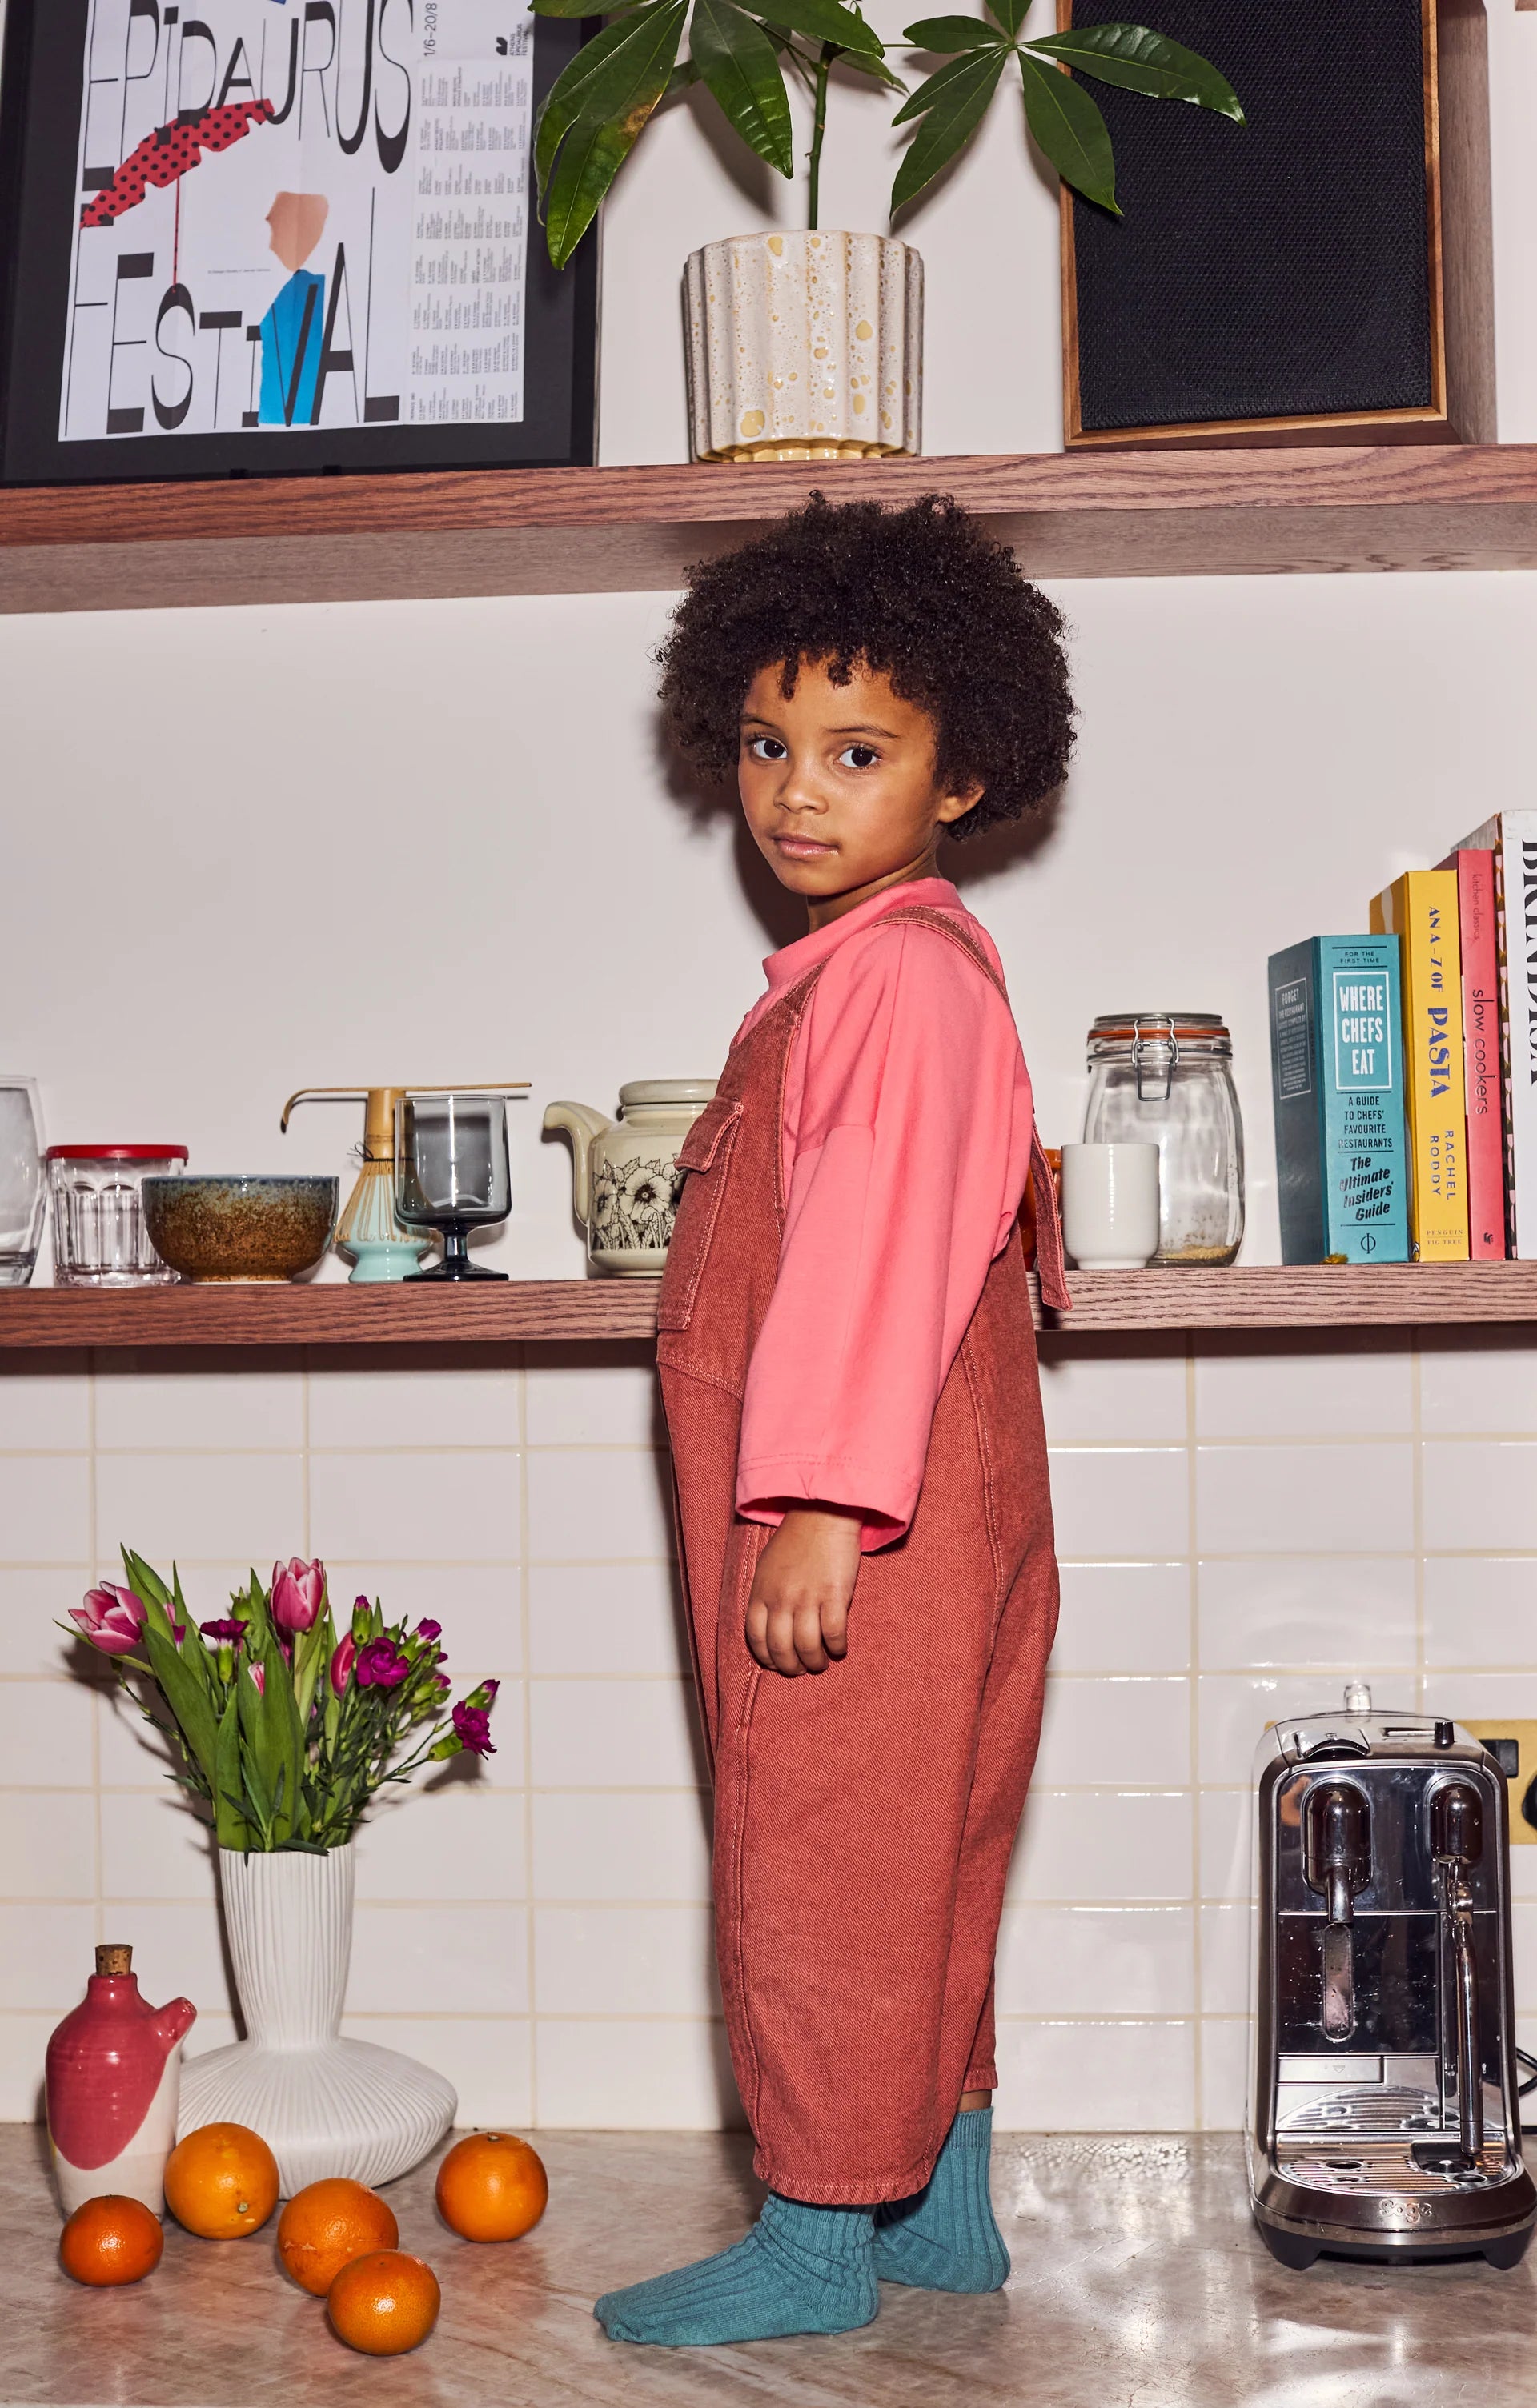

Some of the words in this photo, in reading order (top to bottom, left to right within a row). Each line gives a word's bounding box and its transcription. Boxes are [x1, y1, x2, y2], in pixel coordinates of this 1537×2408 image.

[82, 0, 414, 191] EPIDAURUS
[65, 187, 399, 437] FESTIVAL
[1471, 874, 1483, 905] kitchen
[1429, 906, 1441, 928] AN
[1473, 908, 1484, 940] classics
[1431, 972, 1443, 992] OF
[1282, 988, 1299, 1005] FORGET
[1339, 985, 1384, 1012] WHERE
[1472, 989, 1495, 1031] slow
[1342, 1017, 1383, 1043] CHEFS
[1352, 1049, 1374, 1075] EAT
[1427, 1008, 1451, 1098] PASTA
[1473, 1038, 1496, 1115] cookers
[1348, 1097, 1354, 1106] A
[1356, 1096, 1380, 1105] GUIDE
[1345, 1111, 1354, 1120] TO
[1357, 1110, 1384, 1120] CHEFS'
[1344, 1124, 1386, 1134] FAVOURITE
[1338, 1138, 1392, 1148] RESTAURANTS
[1350, 1157, 1371, 1172] The
[1430, 1136, 1441, 1195] RODDY
[1445, 1130, 1456, 1200] RACHEL
[1339, 1168, 1390, 1191] Ultimate
[1355, 1202, 1390, 1221] Guide
